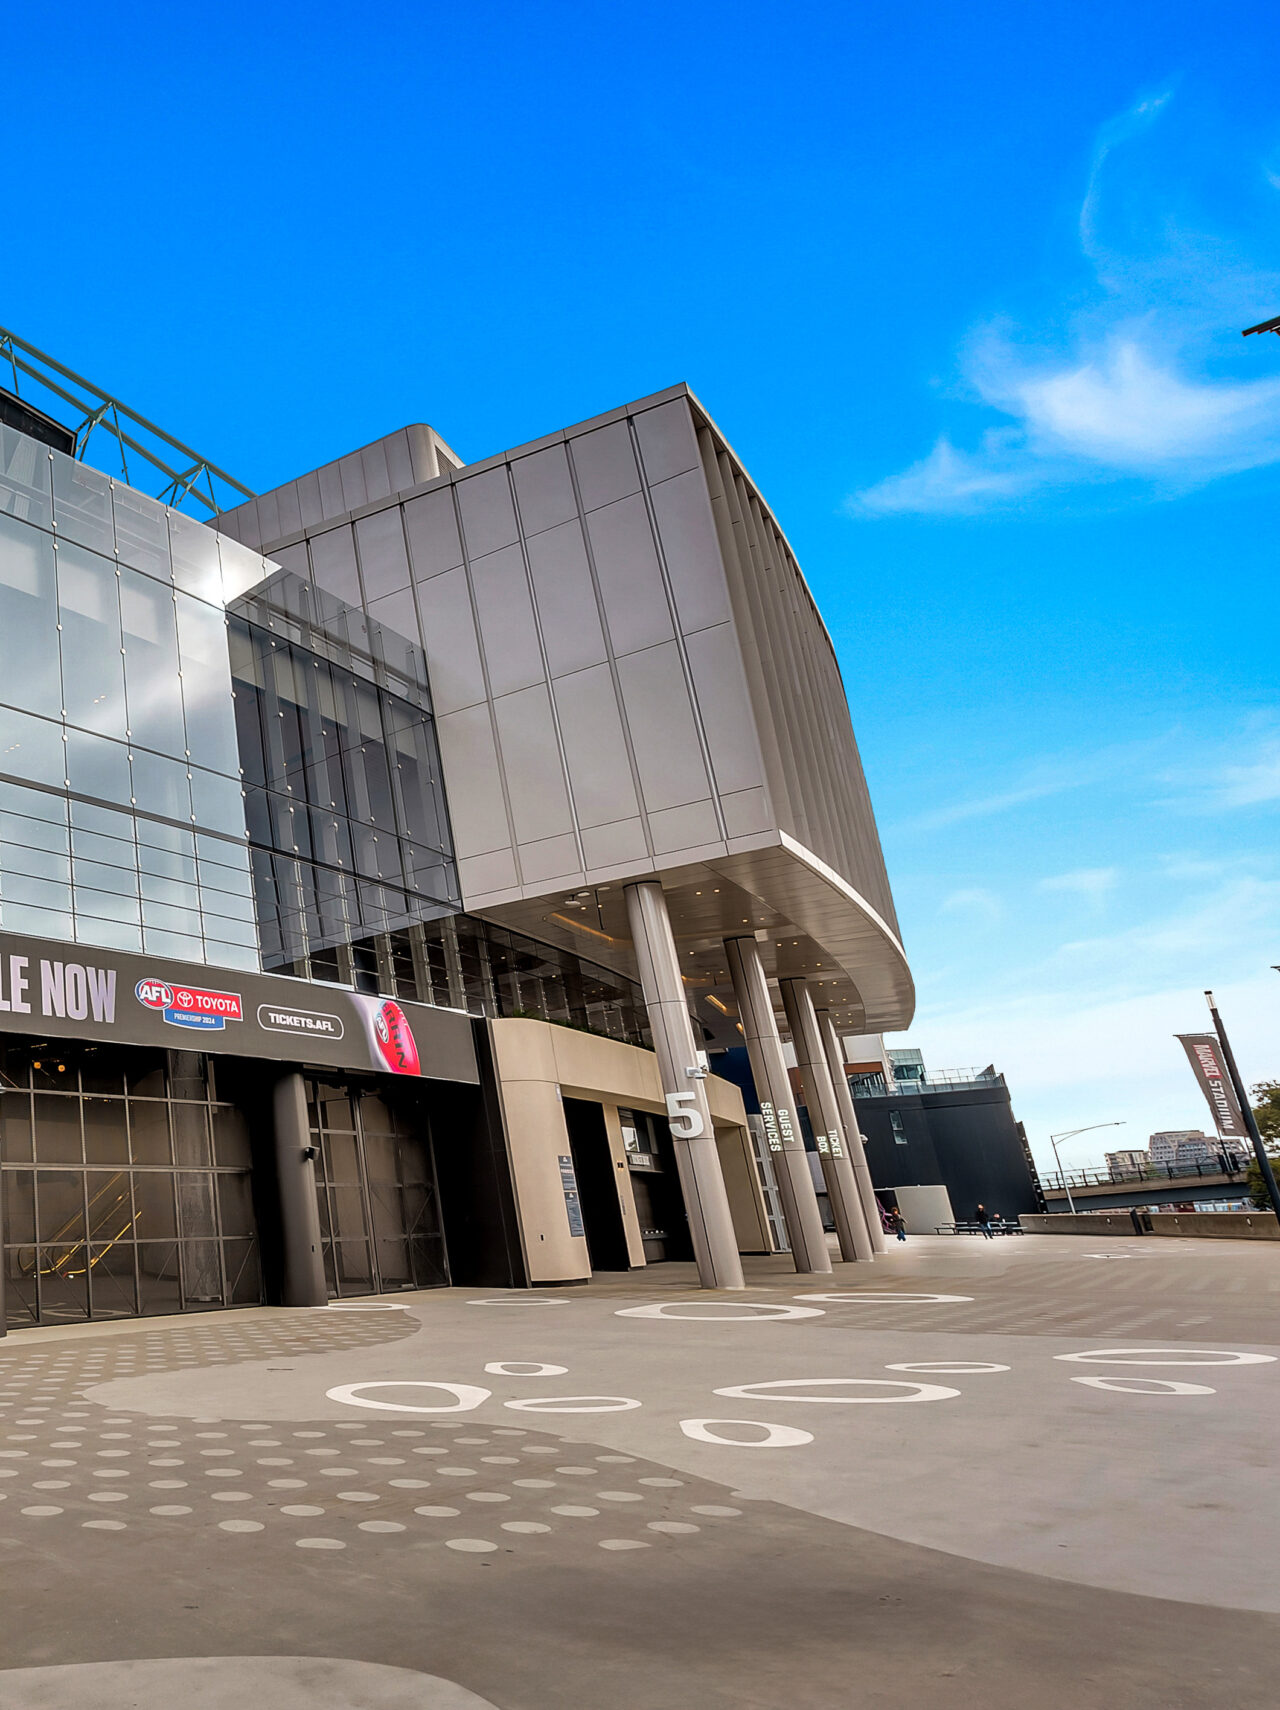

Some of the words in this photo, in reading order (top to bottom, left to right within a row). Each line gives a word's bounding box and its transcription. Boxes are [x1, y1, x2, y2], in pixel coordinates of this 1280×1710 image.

[39, 959, 118, 1024] NOW
[139, 984, 171, 1003] AFL
[195, 995, 239, 1013] TOYOTA
[268, 1012, 335, 1032] TICKETS.AFL
[1193, 1045, 1221, 1077] MARVEL
[1209, 1080, 1235, 1129] STADIUM
[665, 1091, 704, 1138] 5
[760, 1102, 781, 1151] SERVICES
[777, 1109, 794, 1142] GUEST
[816, 1136, 829, 1153] BOX
[828, 1129, 843, 1158] TICKET
